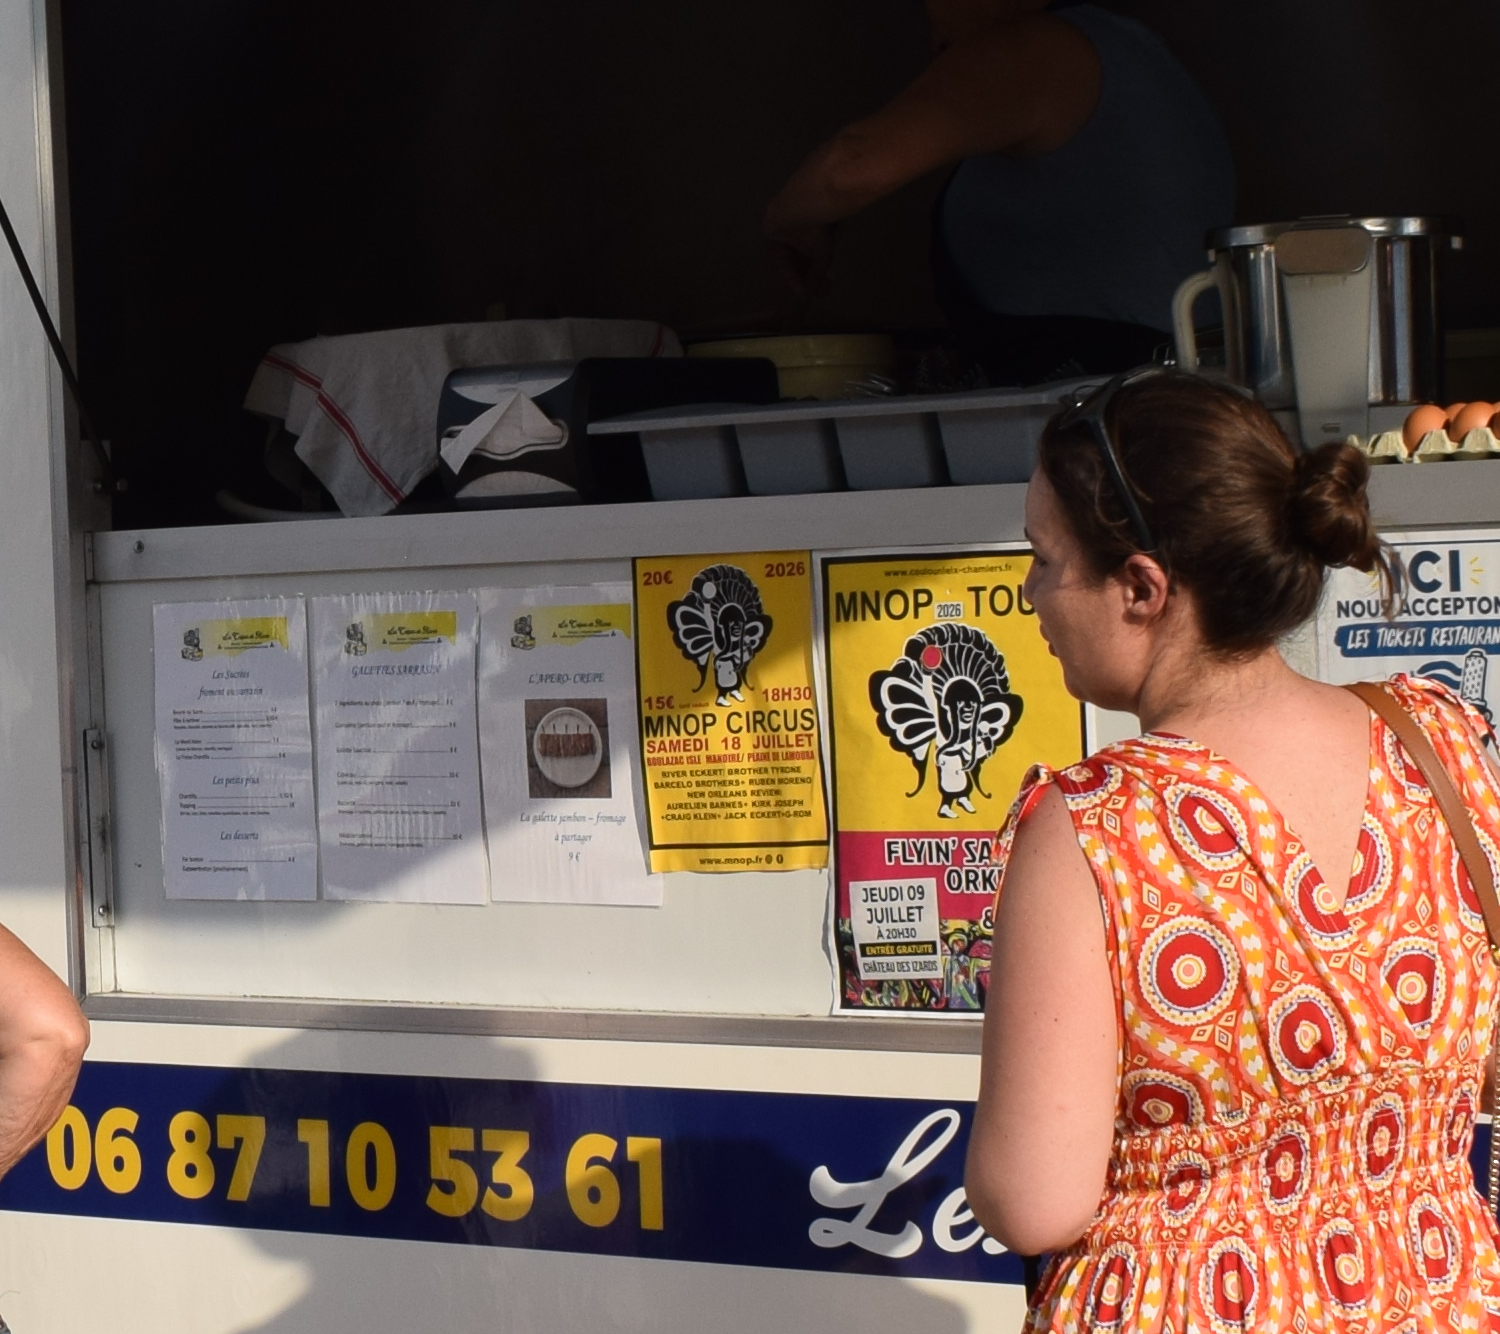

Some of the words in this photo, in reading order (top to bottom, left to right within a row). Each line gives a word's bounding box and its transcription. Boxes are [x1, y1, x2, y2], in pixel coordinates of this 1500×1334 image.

[643, 570, 673, 586] 20€
[765, 561, 806, 578] 2026
[1390, 550, 1461, 594] ICI
[835, 588, 933, 623] MNOP
[937, 603, 961, 617] 2026
[967, 584, 1035, 618] TOU
[1347, 628, 1370, 649] LES
[1377, 626, 1426, 648] TICKETS
[644, 695, 675, 710] 15€
[761, 686, 812, 703] 18H30
[645, 713, 718, 738] MNOP
[726, 708, 815, 735] CIRCUS
[646, 737, 709, 754] SAMEDI
[721, 736, 742, 751] 18
[752, 733, 814, 750] JUILLET
[862, 886, 903, 903] JEUDI
[907, 885, 925, 901] 09
[866, 906, 924, 924] JUILLET
[886, 927, 917, 940] 20H30
[896, 944, 933, 954] GRATUITE
[897, 961, 911, 973] DES
[46, 1104, 142, 1195] 06
[166, 1110, 267, 1202] 87
[297, 1117, 398, 1212] 10
[425, 1125, 535, 1221] 53
[565, 1132, 665, 1231] 61
[808, 1108, 1009, 1258] Le
